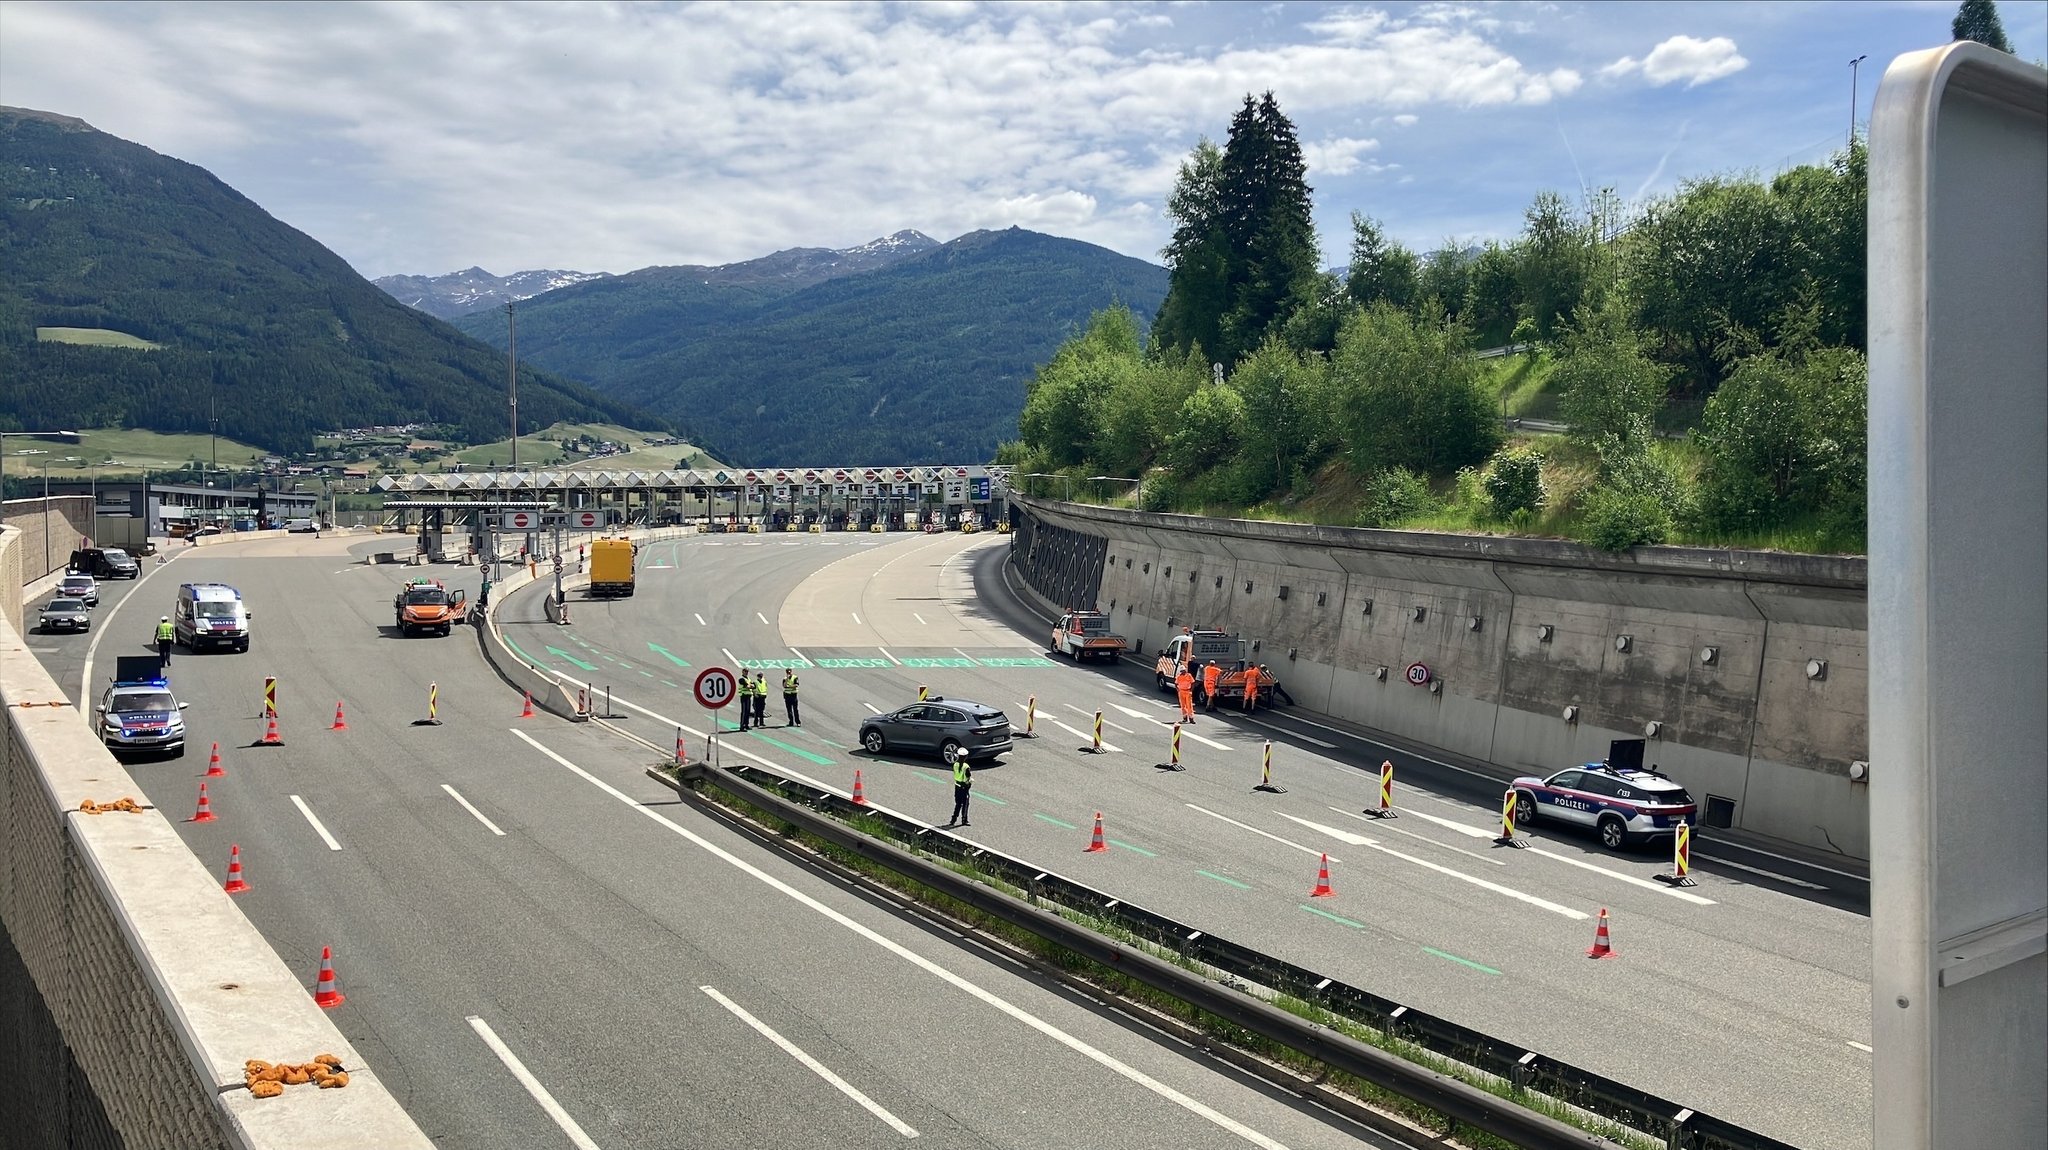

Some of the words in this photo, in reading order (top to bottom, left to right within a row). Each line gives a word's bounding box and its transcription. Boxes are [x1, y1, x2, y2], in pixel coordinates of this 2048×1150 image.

[1411, 668, 1424, 680] 30
[705, 677, 726, 699] 30
[1621, 789, 1631, 798] 133
[1554, 797, 1586, 810] POLIZEI
